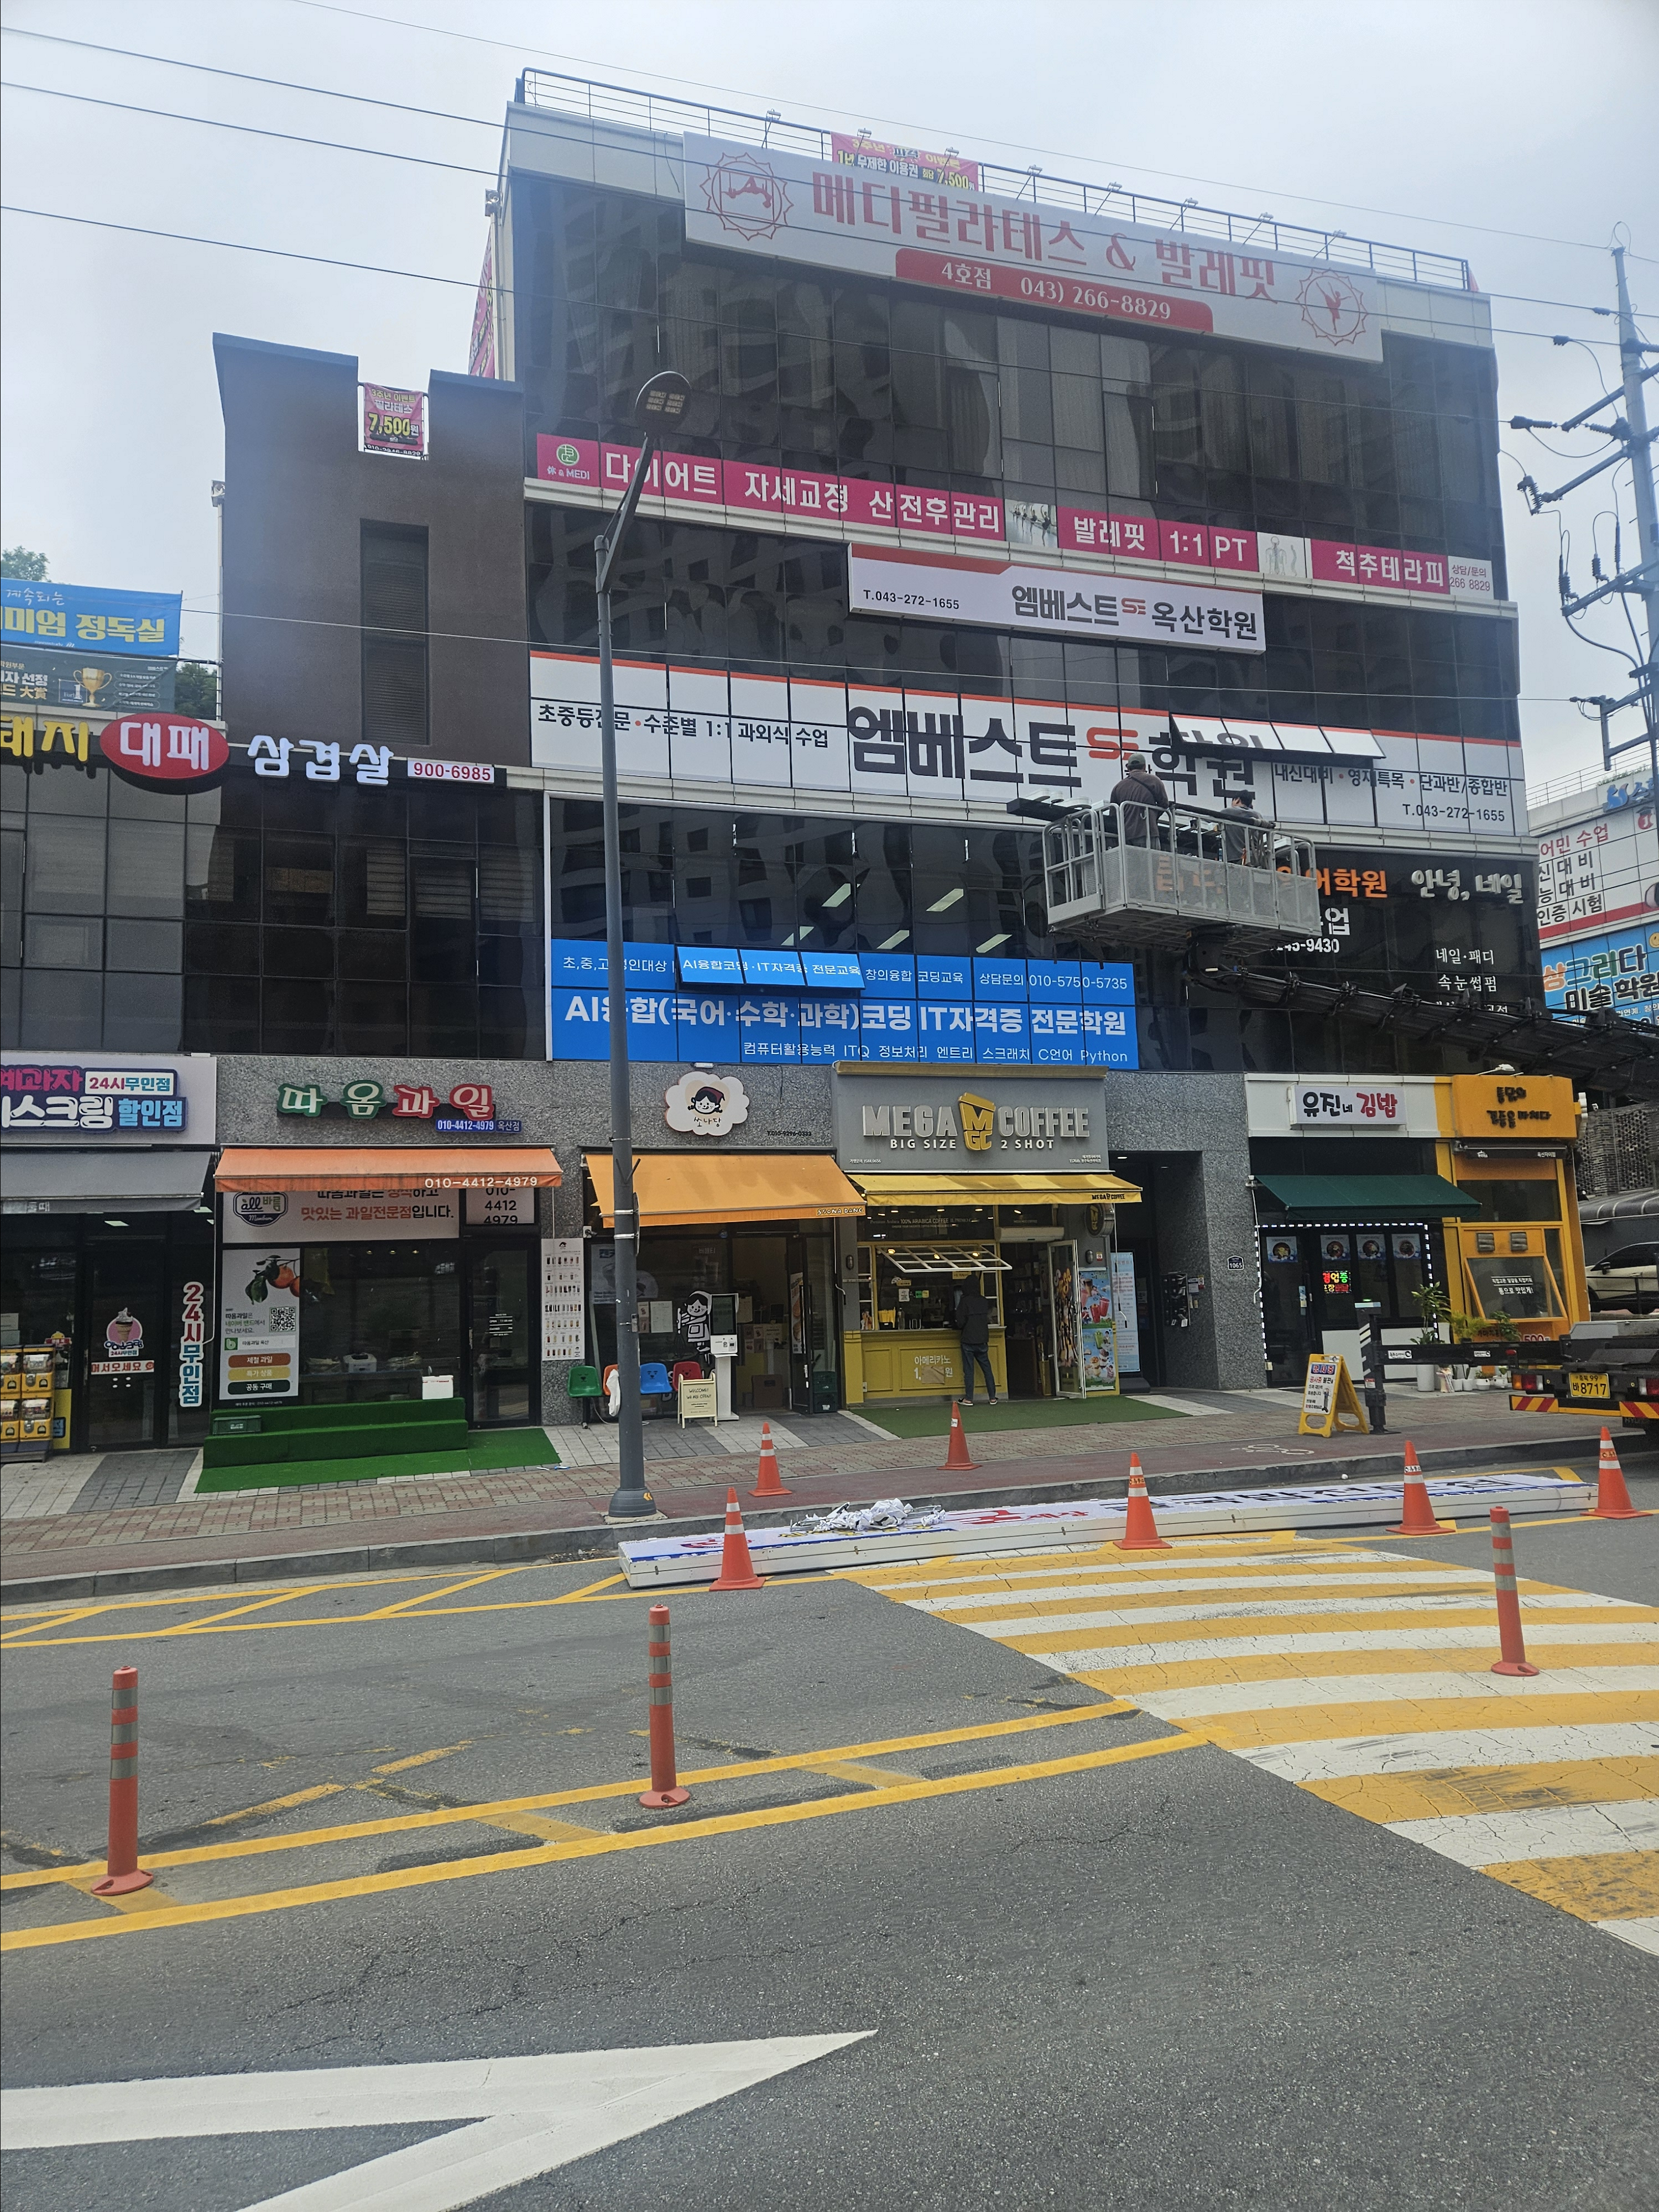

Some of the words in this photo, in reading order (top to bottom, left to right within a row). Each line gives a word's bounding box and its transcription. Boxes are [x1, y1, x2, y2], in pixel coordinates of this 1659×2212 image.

[858, 155, 887, 172] 무제한
[890, 160, 919, 178] 이용권
[812, 171, 1087, 265] 메디필라테스
[1107, 233, 1136, 270] &
[1155, 238, 1278, 304] 발레핏
[941, 262, 992, 290] 4호점
[1021, 277, 1065, 304] 043)
[1072, 286, 1171, 320] 266-8829
[371, 389, 391, 400] 3주년
[374, 399, 413, 414] 필라테스
[368, 413, 419, 436] 7,500원
[566, 469, 590, 480] MEDI
[606, 452, 717, 495] 다이어트
[744, 471, 848, 513] 자세교정
[869, 490, 999, 533] 산전후관리
[1074, 517, 1145, 551] 발레핏
[1170, 530, 1203, 557] 1:1
[1215, 536, 1247, 561] PT
[1335, 549, 1444, 587] 척추테라피
[1452, 564, 1487, 578] 상담/문의
[1449, 576, 1465, 589] 266
[1469, 578, 1490, 592] 8829
[863, 589, 960, 610] T.043-272-1655
[0, 606, 66, 638] 미엄
[75, 613, 165, 643] 정독실
[1, 670, 19, 684] 자
[22, 673, 49, 687] 선정
[1, 683, 16, 696] 드
[644, 715, 697, 737] 수준별
[707, 720, 732, 738] 1:1
[738, 722, 790, 745] 과외식
[796, 728, 828, 748] 수업
[120, 722, 209, 770] 대패
[247, 734, 394, 786] 삼겹살
[413, 761, 492, 781] 900-6985
[1275, 764, 1333, 784] 내신대비
[1402, 804, 1505, 822] T.043-272-1655
[1540, 835, 1571, 857] 어민
[1576, 823, 1609, 849] 수업
[1557, 851, 1594, 877] 대비
[1411, 868, 1470, 902] 안녕,
[1475, 872, 1524, 904] 네일
[1559, 873, 1596, 898] 대비
[1537, 904, 1567, 927] 인증
[1572, 894, 1603, 917] 시험
[812, 964, 861, 976] 전문교육
[865, 969, 912, 982] 창의융합
[918, 971, 963, 984] 코딩교육
[979, 974, 1024, 986] 상담문의
[1029, 974, 1127, 990] 010-5750-5735
[1438, 974, 1497, 992] 속눈썹펌
[1565, 983, 1612, 1011] 미술
[1614, 971, 1659, 1000] 학원
[921, 1006, 1022, 1033] IT자격증
[1031, 1010, 1126, 1036] 전문학원
[743, 1042, 836, 1057] 컴퓨터활용능력
[844, 1045, 870, 1058] ITQ
[879, 1045, 927, 1059] 정보처리
[937, 1046, 973, 1060] 엔트리
[982, 1047, 1030, 1060] 스크래치
[1038, 1048, 1073, 1061] C언어
[1081, 1050, 1128, 1062] Python
[89, 1077, 170, 1091] 24시무인점
[281, 1083, 491, 1118] 따옴과일
[1357, 1092, 1398, 1118] 김밥
[118, 1098, 182, 1126] 할인점
[863, 1105, 958, 1138] MEGA
[998, 1106, 1089, 1138] COFFEE
[437, 1120, 494, 1131] 010-4412-4979
[498, 1121, 520, 1132] 옥산점
[890, 1139, 915, 1149] BIG
[924, 1139, 957, 1149] SIZE
[1001, 1140, 1008, 1149] 2
[1015, 1140, 1054, 1150] SHOT
[425, 1177, 538, 1188] 010-4412-4979
[301, 1206, 342, 1221] 맛있는
[346, 1204, 455, 1220] 과일전문점입니다.
[484, 1200, 517, 1211] 4412
[182, 1284, 202, 1405] 24시무인점
[91, 1362, 142, 1373] 어서오세요
[914, 1354, 951, 1365] 아메리카노
[1313, 1364, 1334, 1374] 공사중
